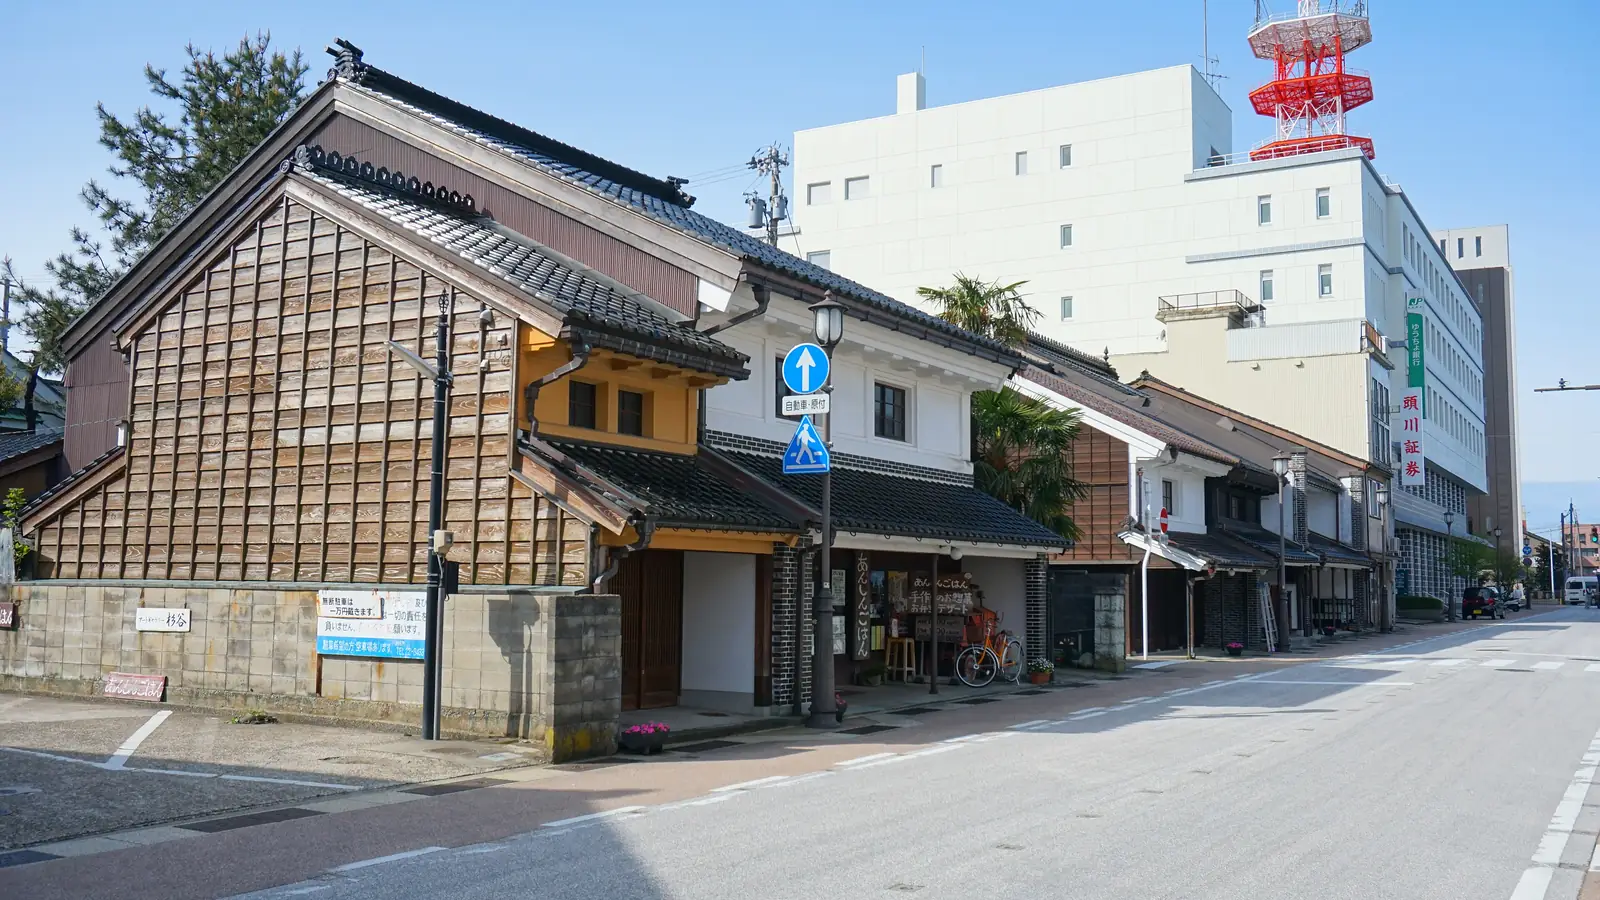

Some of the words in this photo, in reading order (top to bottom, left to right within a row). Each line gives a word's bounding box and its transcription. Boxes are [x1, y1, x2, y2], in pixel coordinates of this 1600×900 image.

[1412, 323, 1420, 366] ゆうちょ銀行
[786, 399, 826, 411] 自動車・原付
[1403, 395, 1421, 477] 頭川証券
[914, 578, 968, 589] あんんごはん
[322, 597, 353, 606] 無断駐車は
[857, 552, 869, 657] あんしんごはん
[909, 590, 973, 605] 手作のお惣菜
[166, 612, 187, 627] 杉谷
[104, 677, 163, 698] あんしんごはん
